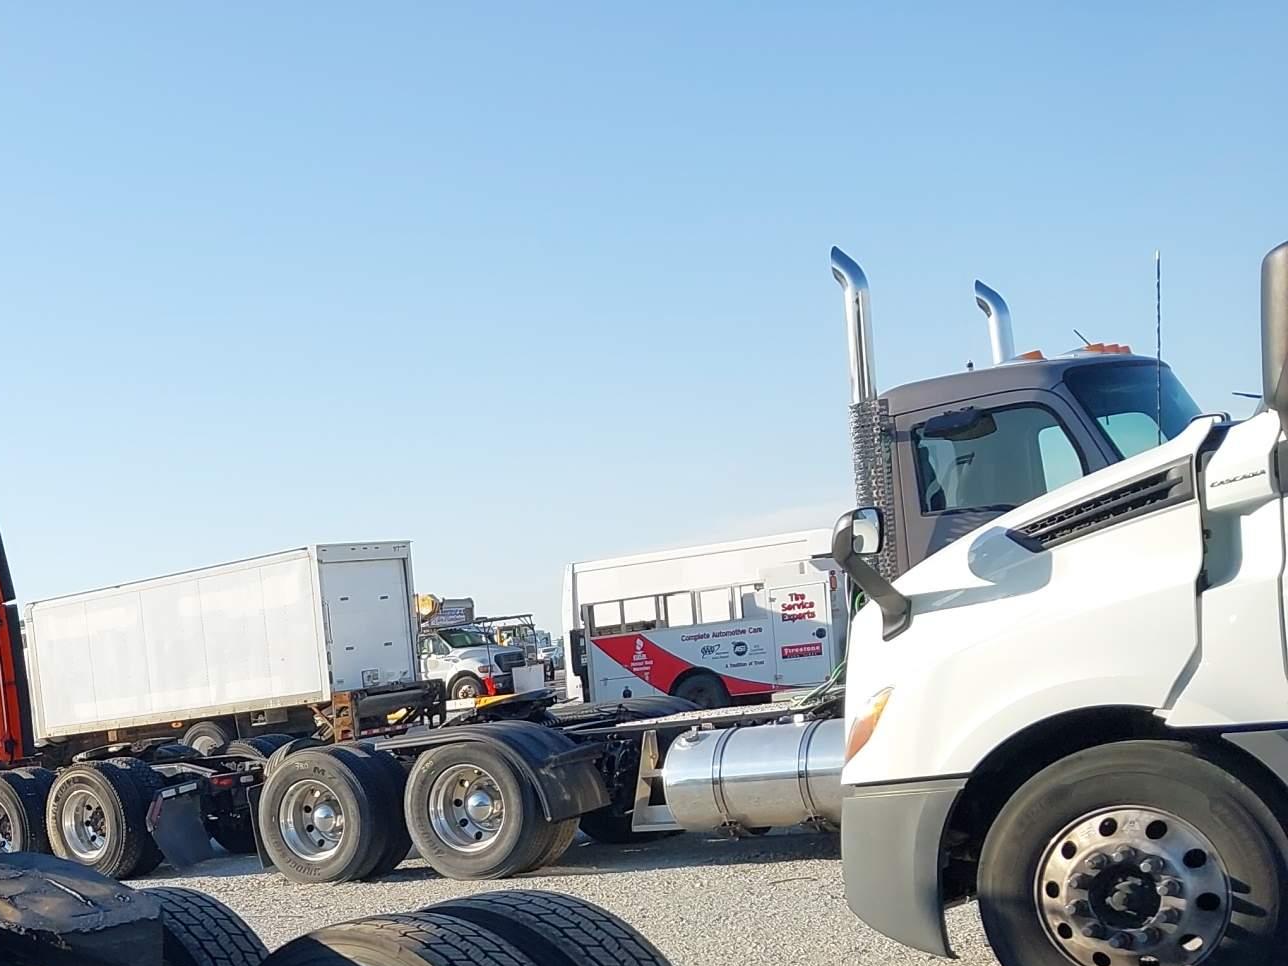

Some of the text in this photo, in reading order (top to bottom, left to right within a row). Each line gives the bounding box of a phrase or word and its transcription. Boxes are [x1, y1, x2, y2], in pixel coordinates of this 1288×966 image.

[788, 592, 806, 602] Tire
[781, 601, 815, 612] Service
[781, 611, 816, 623] Experts
[680, 626, 763, 642] Complete Automotive Care
[783, 645, 821, 656] Firestone
